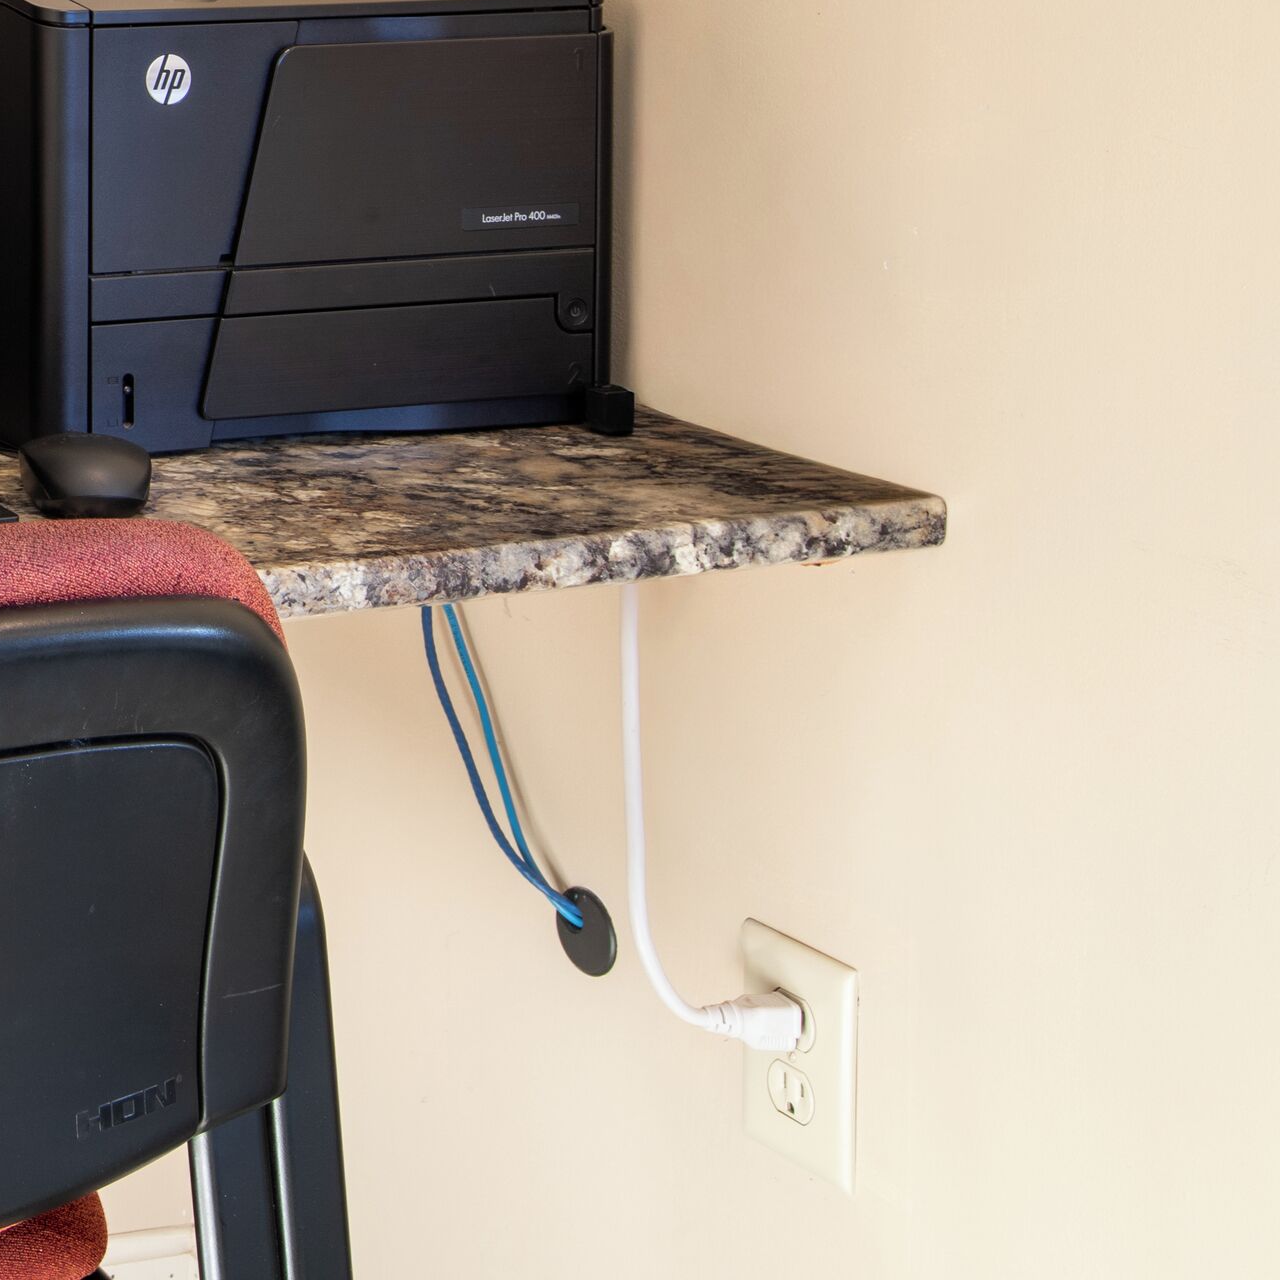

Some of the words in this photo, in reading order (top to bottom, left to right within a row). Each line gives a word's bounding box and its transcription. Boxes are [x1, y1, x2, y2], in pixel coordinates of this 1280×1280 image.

[152, 53, 186, 106] hp
[482, 213, 513, 223] LaserJet
[514, 212, 527, 222] Pro
[528, 210, 546, 220] 400
[75, 1077, 178, 1140] HON
